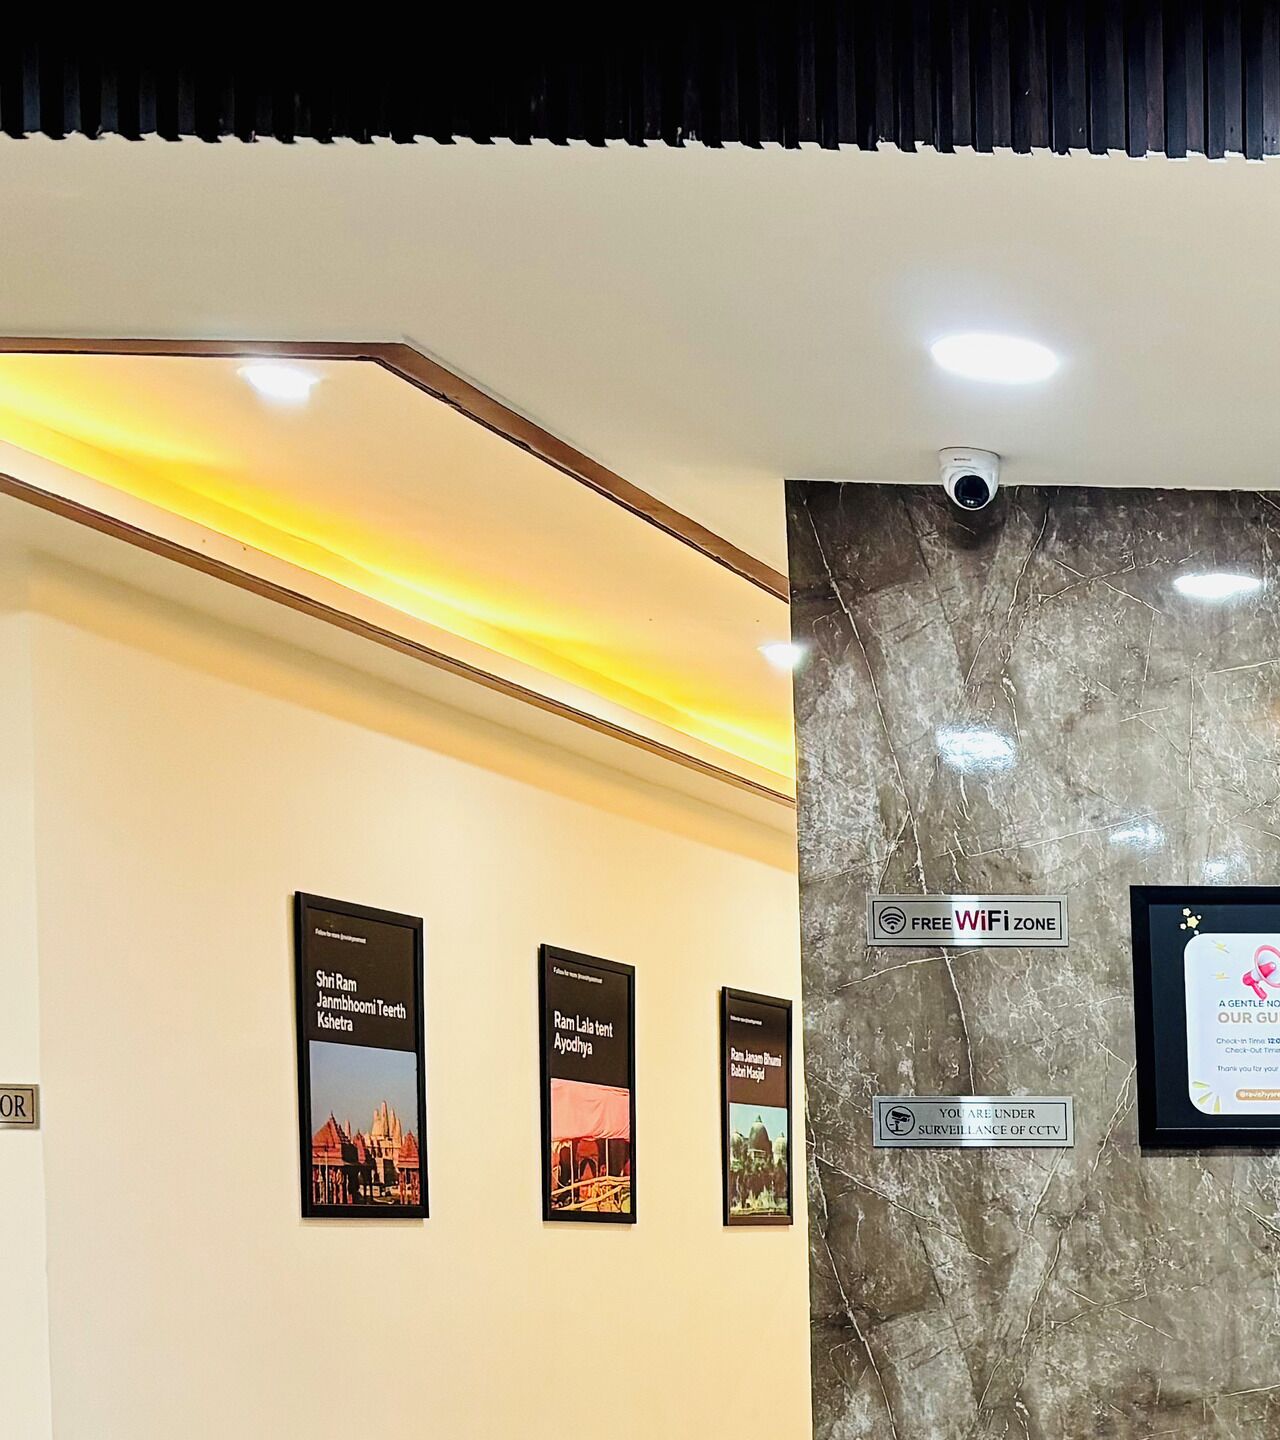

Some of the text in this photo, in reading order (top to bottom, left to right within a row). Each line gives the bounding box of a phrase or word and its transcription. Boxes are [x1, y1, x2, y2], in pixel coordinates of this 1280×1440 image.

[912, 909, 1056, 931] FREE WiFi ZONE
[316, 969, 357, 993] Shri Ram
[316, 990, 407, 1020] Janmbhoomi Teerth
[1219, 1000, 1226, 1008] A
[1228, 1000, 1264, 1008] GENTLE
[317, 1010, 354, 1032] Kshetra
[554, 1010, 613, 1038] Ram Lala tent
[1218, 1012, 1253, 1023] OUR
[554, 1032, 593, 1058] Ayodhya
[730, 1047, 744, 1062] Ram
[730, 1063, 765, 1083] Babri Masjid
[1217, 1065, 1237, 1073] Thank
[1239, 1065, 1252, 1073] you
[939, 1108, 1036, 1119] YOU ARE UNDER
[918, 1124, 1061, 1135] SURVEILLANCE OF CCTV
